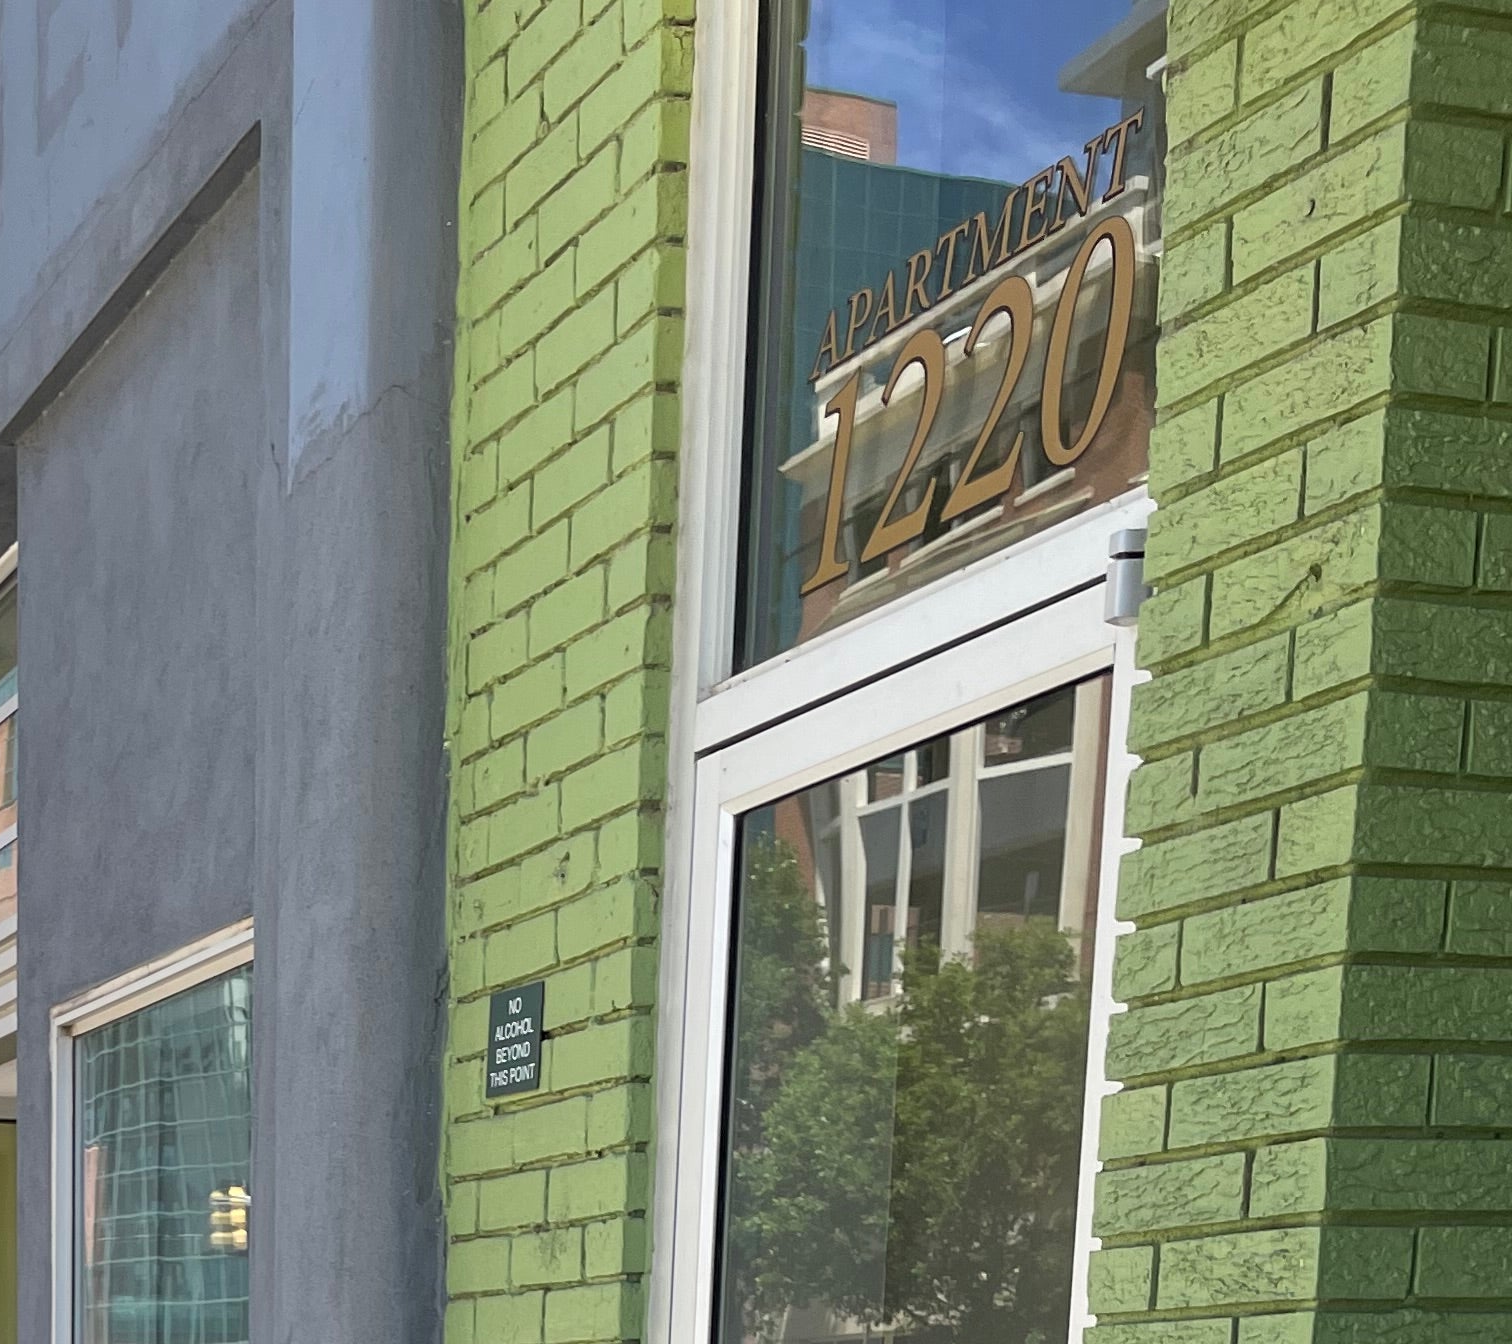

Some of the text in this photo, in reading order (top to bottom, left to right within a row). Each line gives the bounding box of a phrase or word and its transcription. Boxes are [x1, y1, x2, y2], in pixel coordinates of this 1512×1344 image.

[808, 106, 1144, 382] APARTMENT
[799, 214, 1136, 596] 1220
[509, 997, 522, 1014] NO
[494, 1018, 535, 1041] ALCOHOL
[496, 1042, 530, 1064] BEYOND
[490, 1063, 535, 1088] THIS POINT
